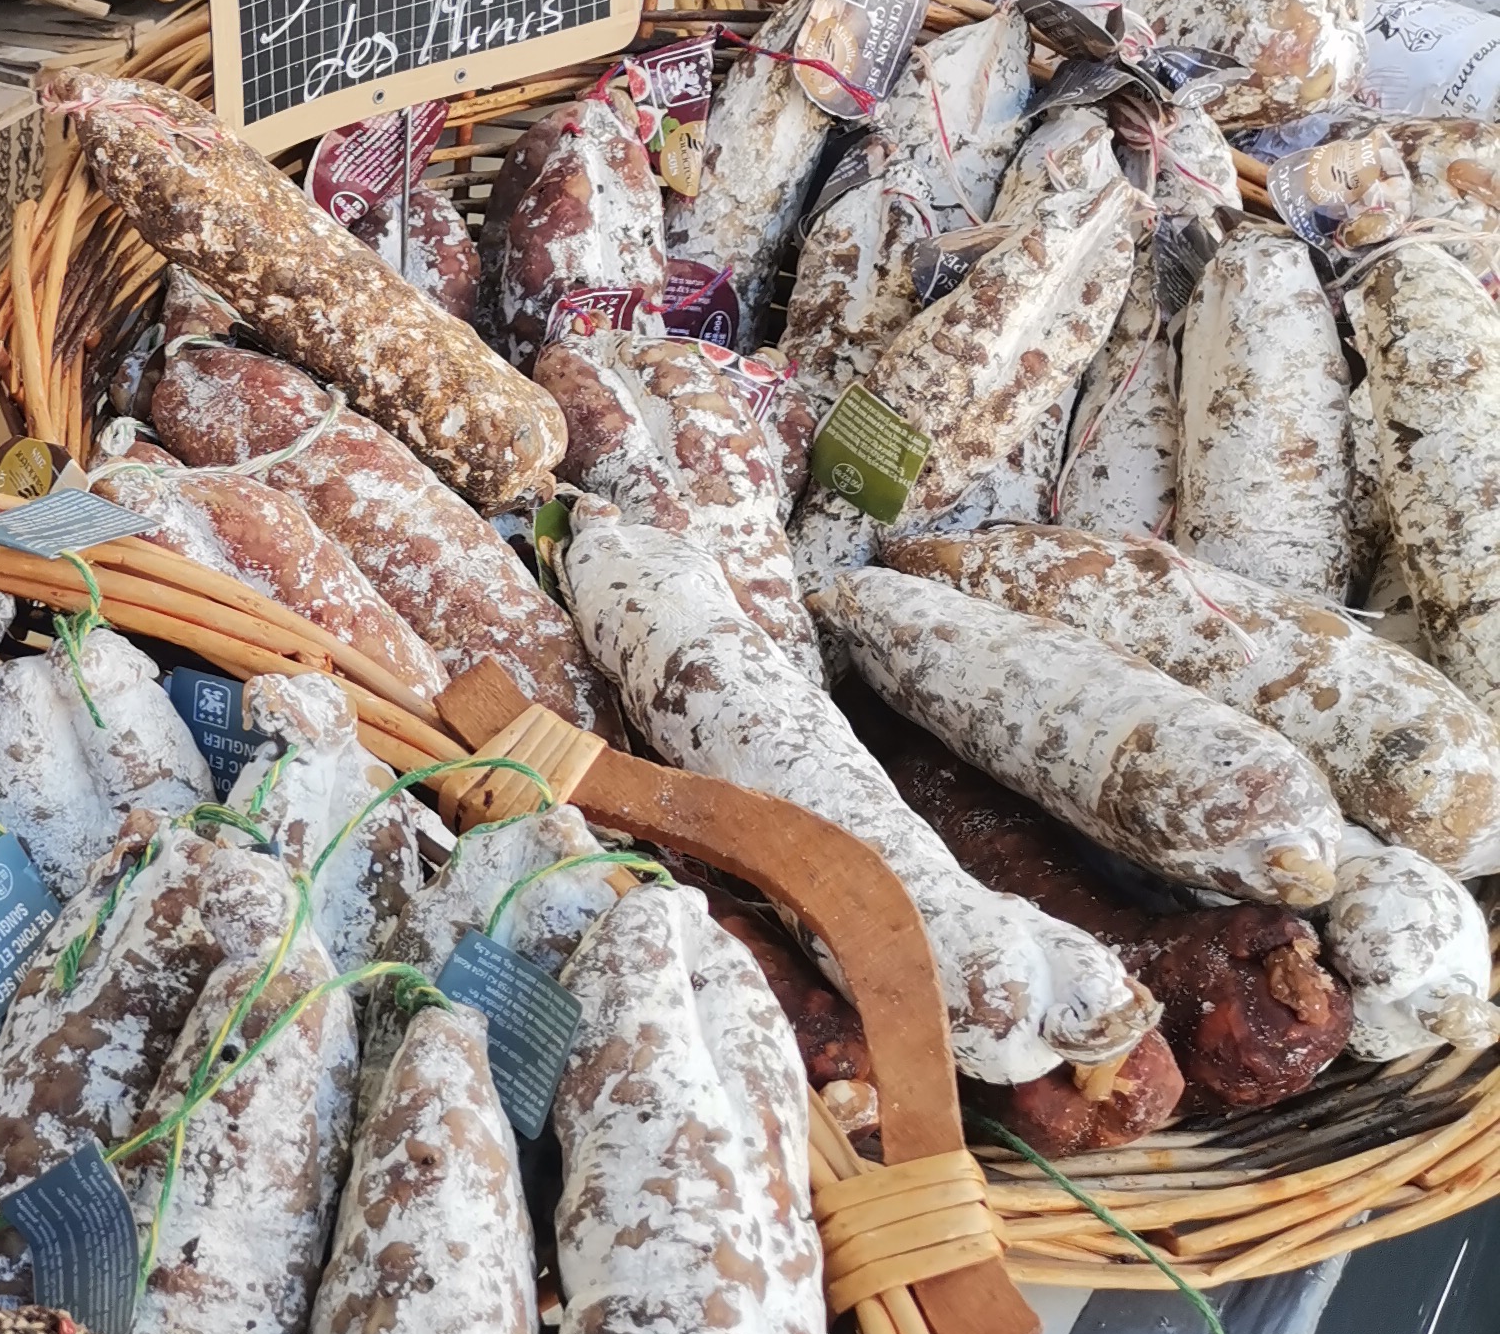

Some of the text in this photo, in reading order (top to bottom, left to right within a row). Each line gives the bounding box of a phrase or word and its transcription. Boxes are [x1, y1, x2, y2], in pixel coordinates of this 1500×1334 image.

[39, 908, 56, 926] DE
[11, 922, 41, 955] PORC
[0, 946, 16, 969] ET
